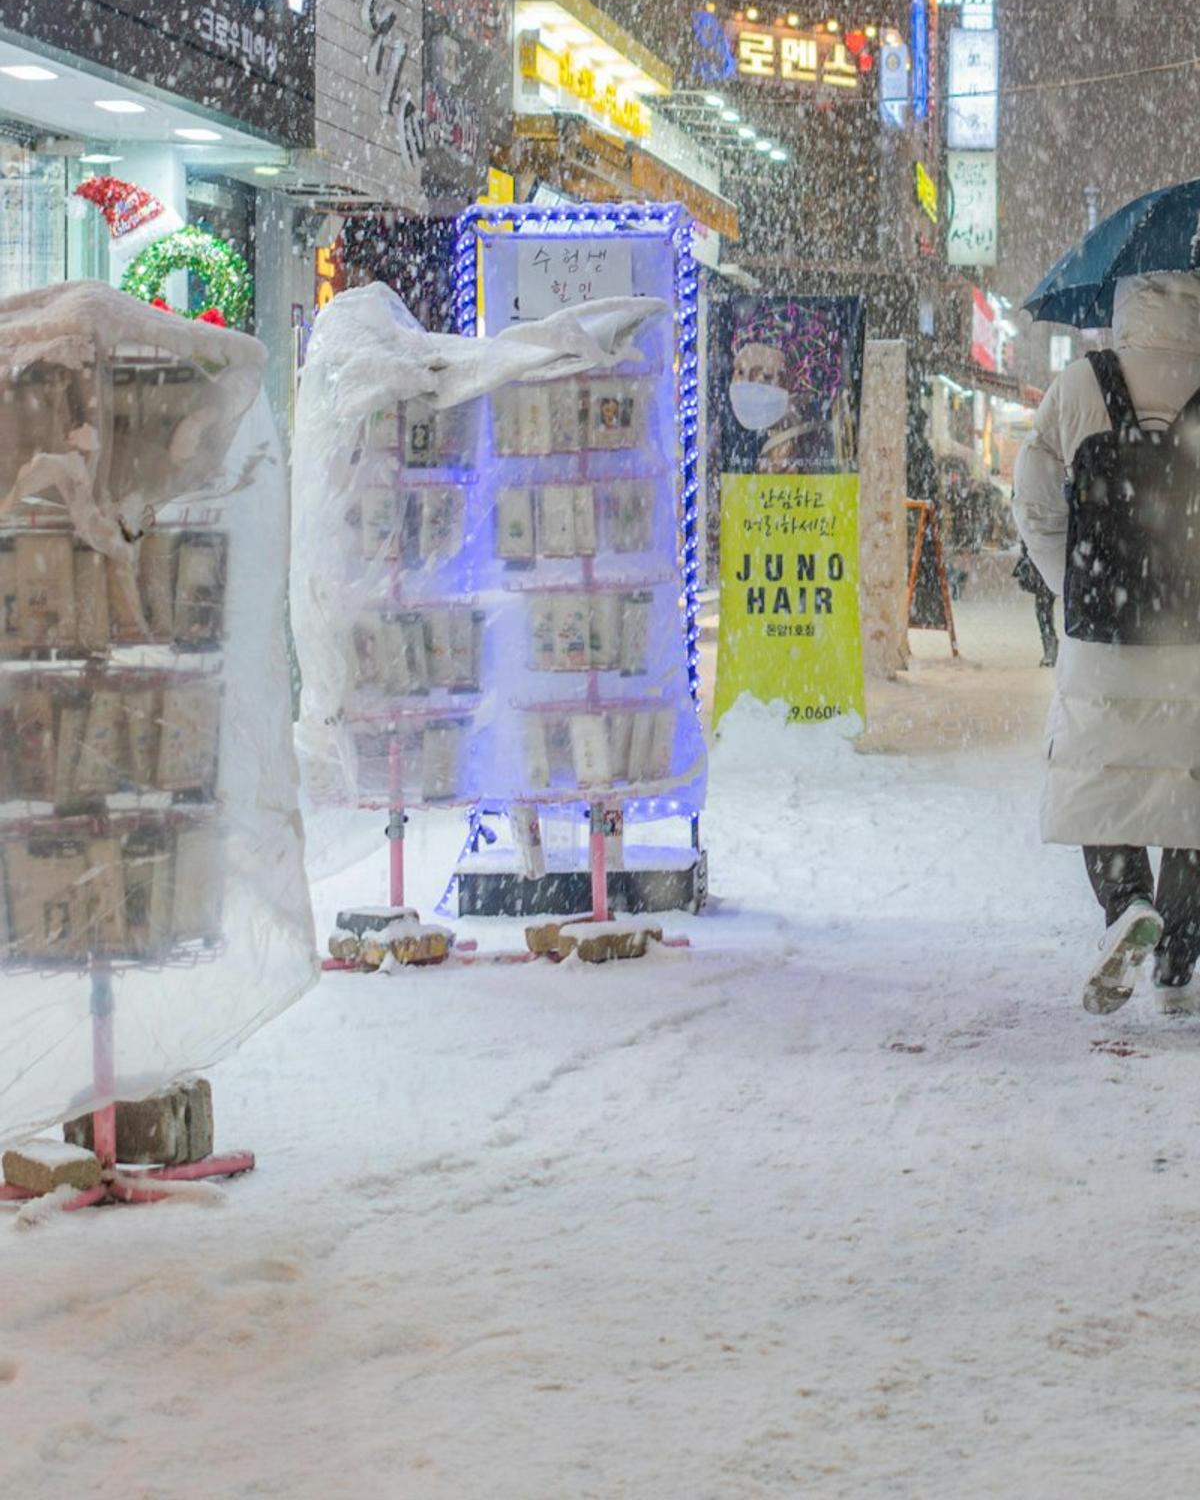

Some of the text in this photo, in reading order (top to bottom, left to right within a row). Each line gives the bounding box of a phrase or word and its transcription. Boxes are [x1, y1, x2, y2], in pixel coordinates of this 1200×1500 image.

[531, 245, 608, 275] 수험생
[550, 280, 595, 303] 할인
[759, 487, 826, 510] 안심하고
[743, 515, 837, 538] 머리하세요!
[735, 552, 845, 582] JUNO
[746, 586, 834, 615] HAIR
